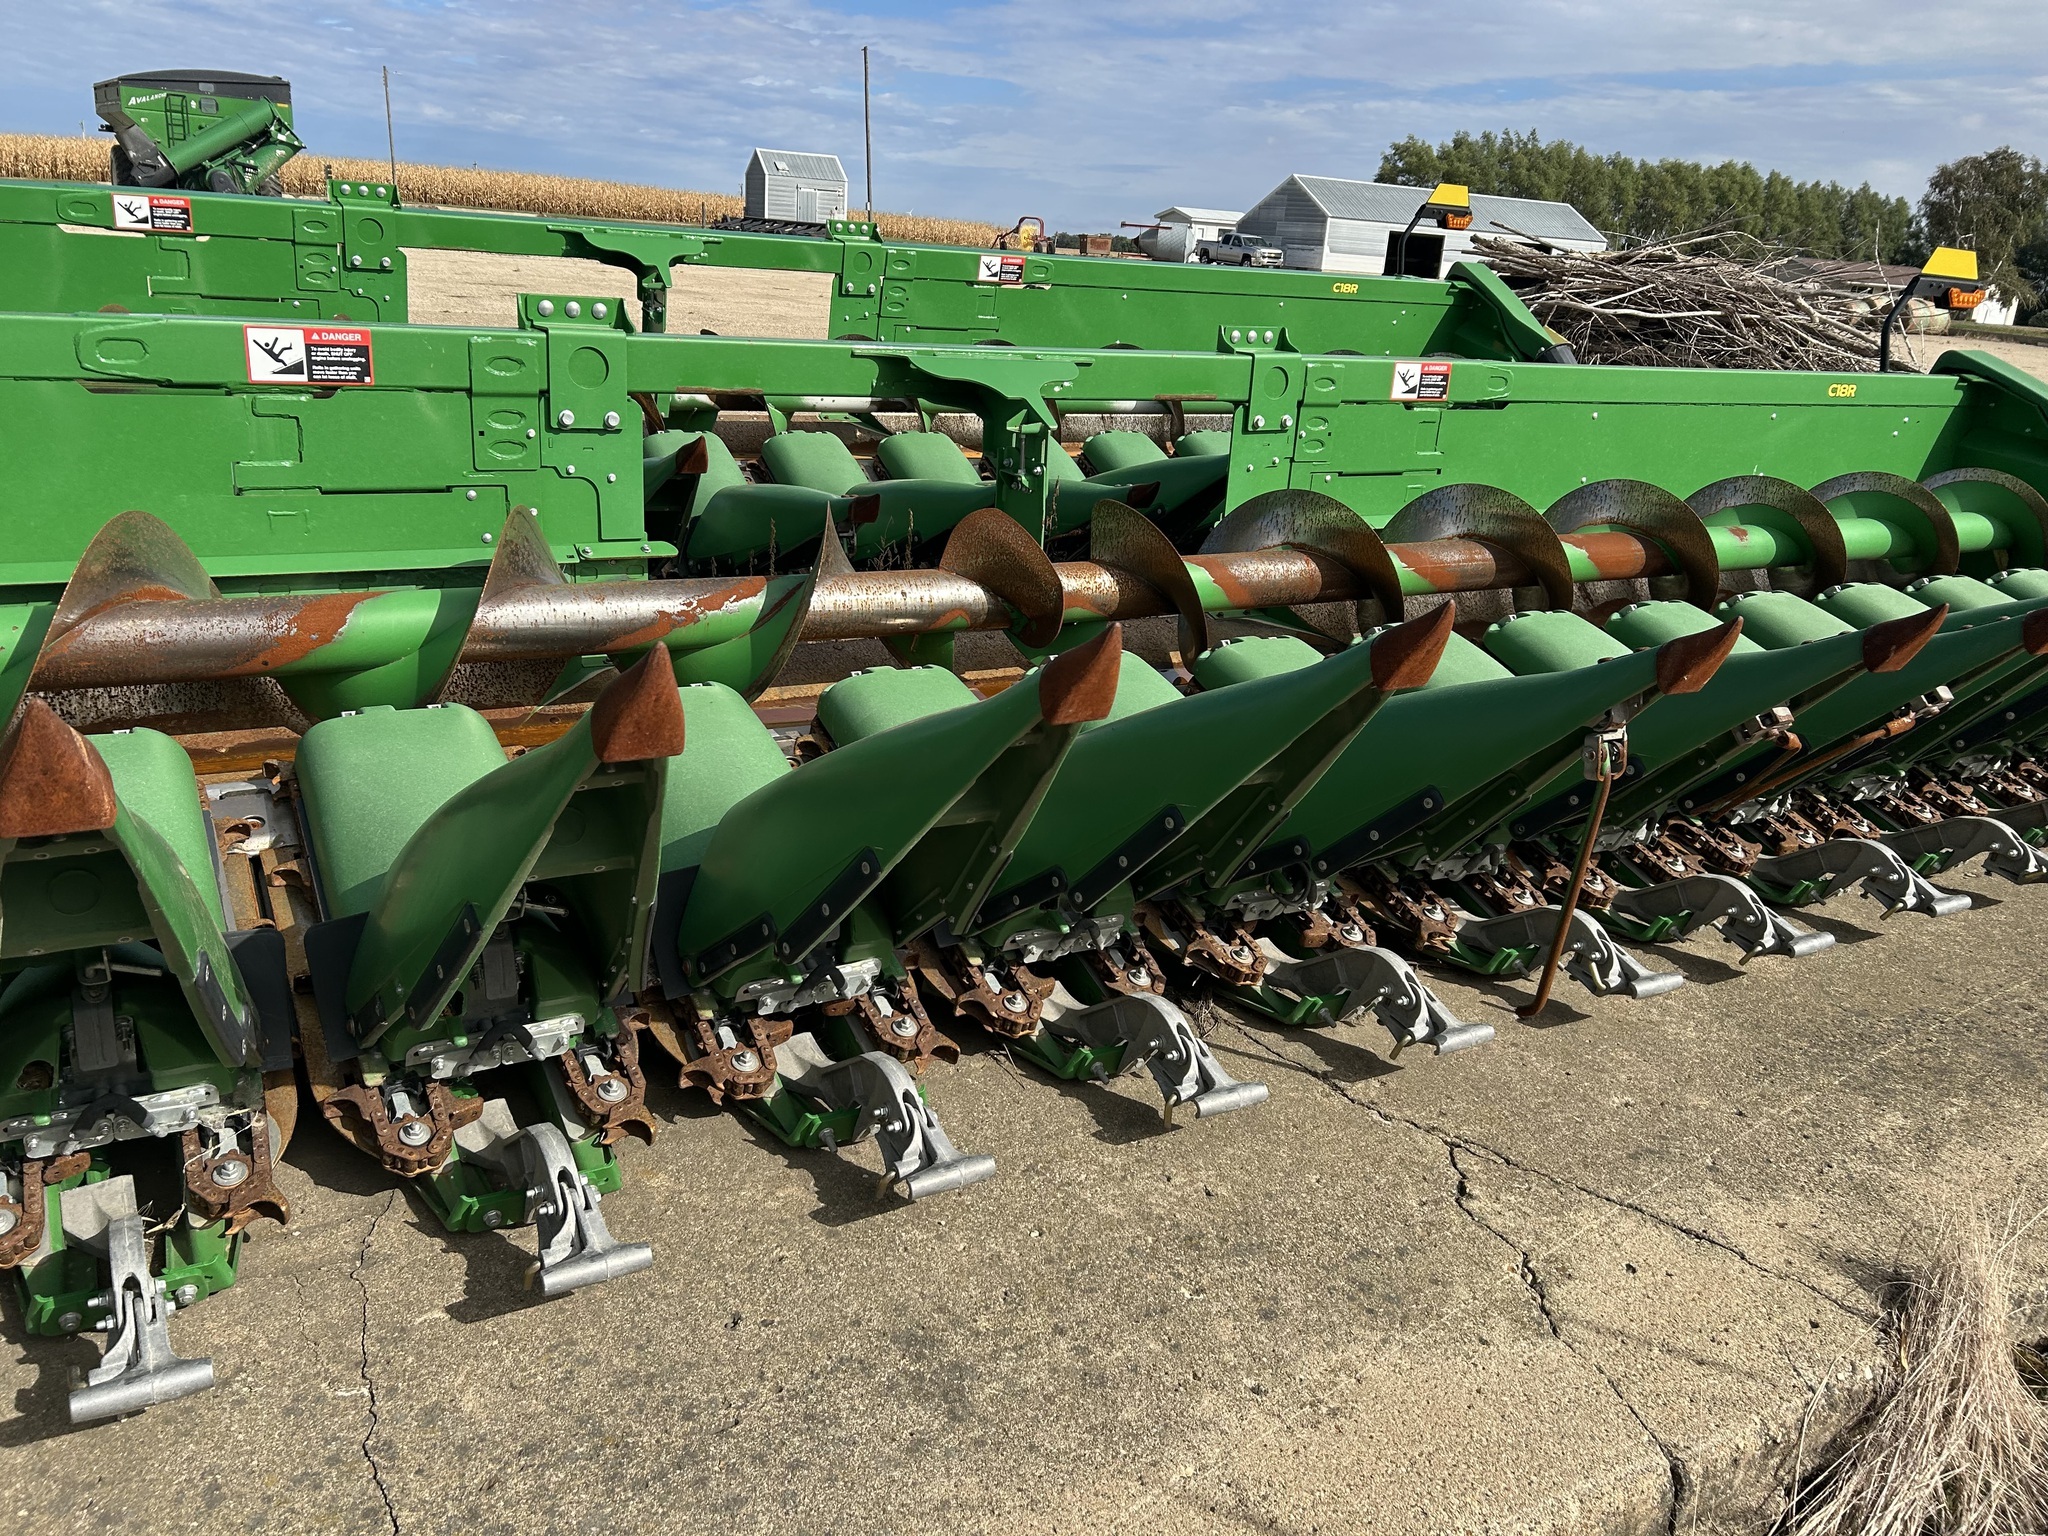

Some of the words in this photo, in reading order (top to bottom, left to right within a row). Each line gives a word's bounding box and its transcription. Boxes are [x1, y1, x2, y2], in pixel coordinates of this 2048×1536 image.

[159, 198, 185, 206] DANGER
[1332, 282, 1359, 294] C18R
[321, 332, 362, 341] DANGER
[1828, 383, 1857, 397] C18R
